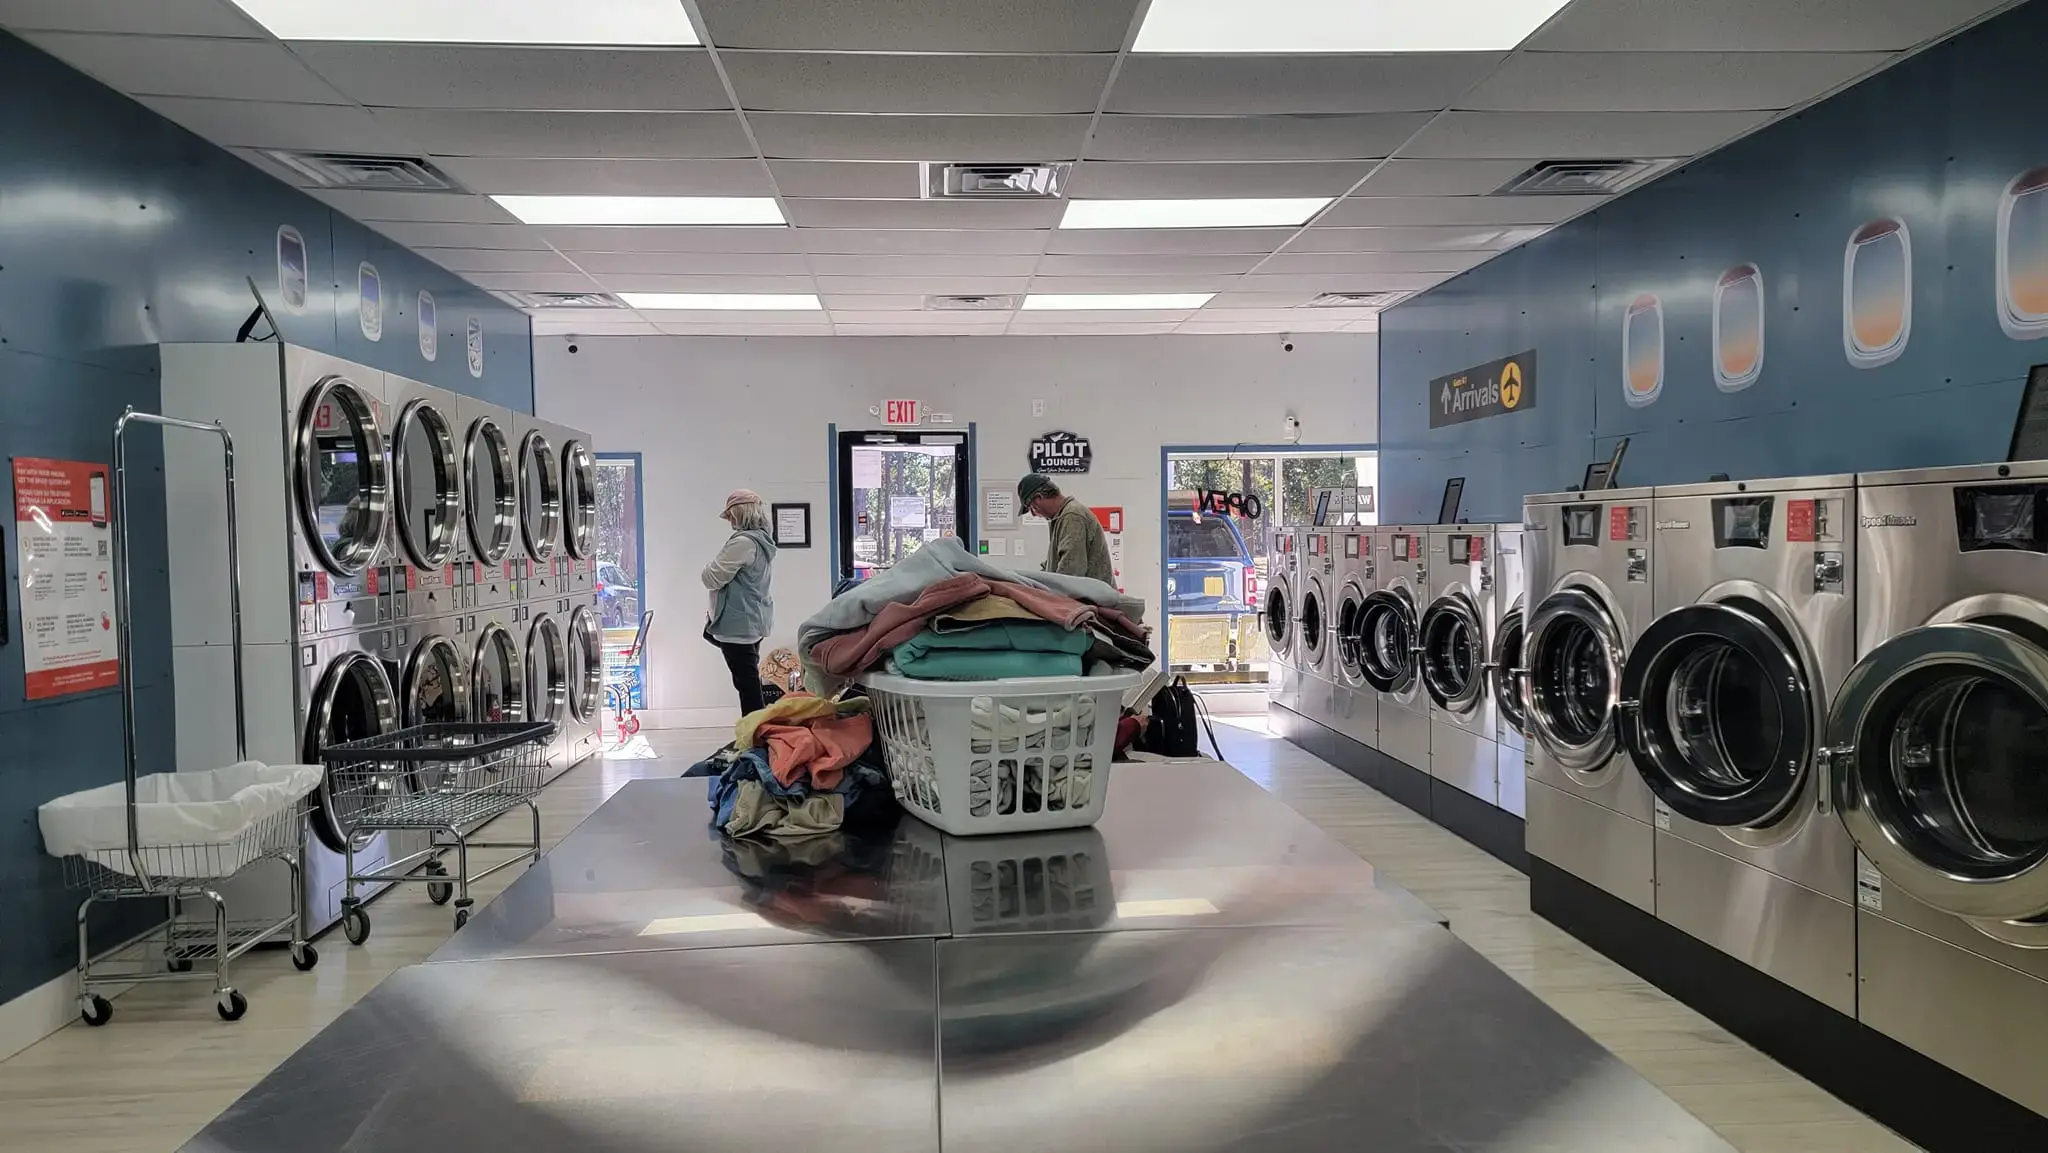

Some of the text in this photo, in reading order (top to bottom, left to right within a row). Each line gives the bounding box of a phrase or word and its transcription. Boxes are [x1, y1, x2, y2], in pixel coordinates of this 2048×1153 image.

[1452, 378, 1499, 413] Arrivals
[887, 400, 916, 423] EXIT
[1033, 442, 1087, 459] PILOT
[1040, 458, 1080, 466] LOUNGE
